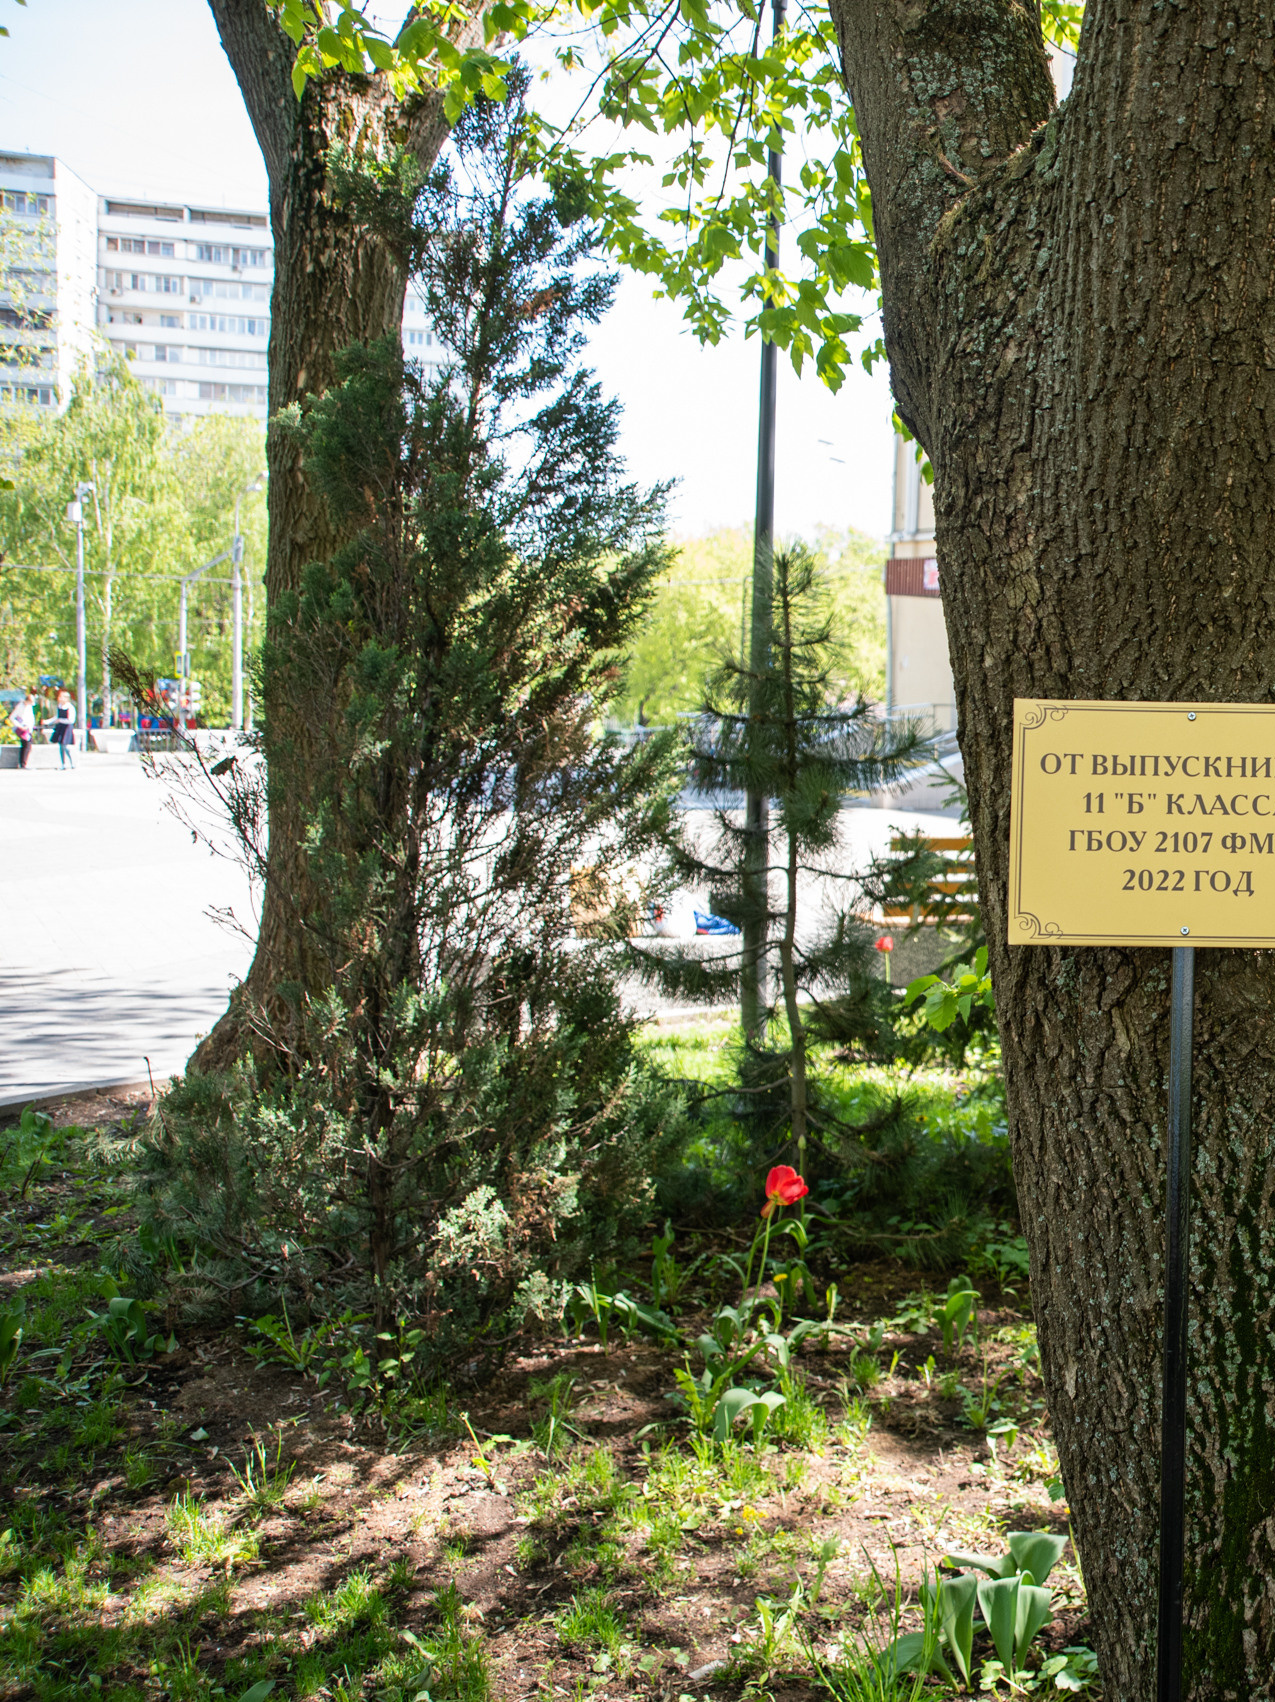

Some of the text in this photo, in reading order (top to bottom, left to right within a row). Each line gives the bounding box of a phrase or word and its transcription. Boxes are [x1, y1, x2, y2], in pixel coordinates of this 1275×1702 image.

[1040, 752, 1084, 775] ОТ
[1083, 792, 1105, 814] 11
[1068, 829, 1147, 853] ГБОУ
[1154, 831, 1213, 853] 2107
[1122, 868, 1255, 897] 2022 ГОД
